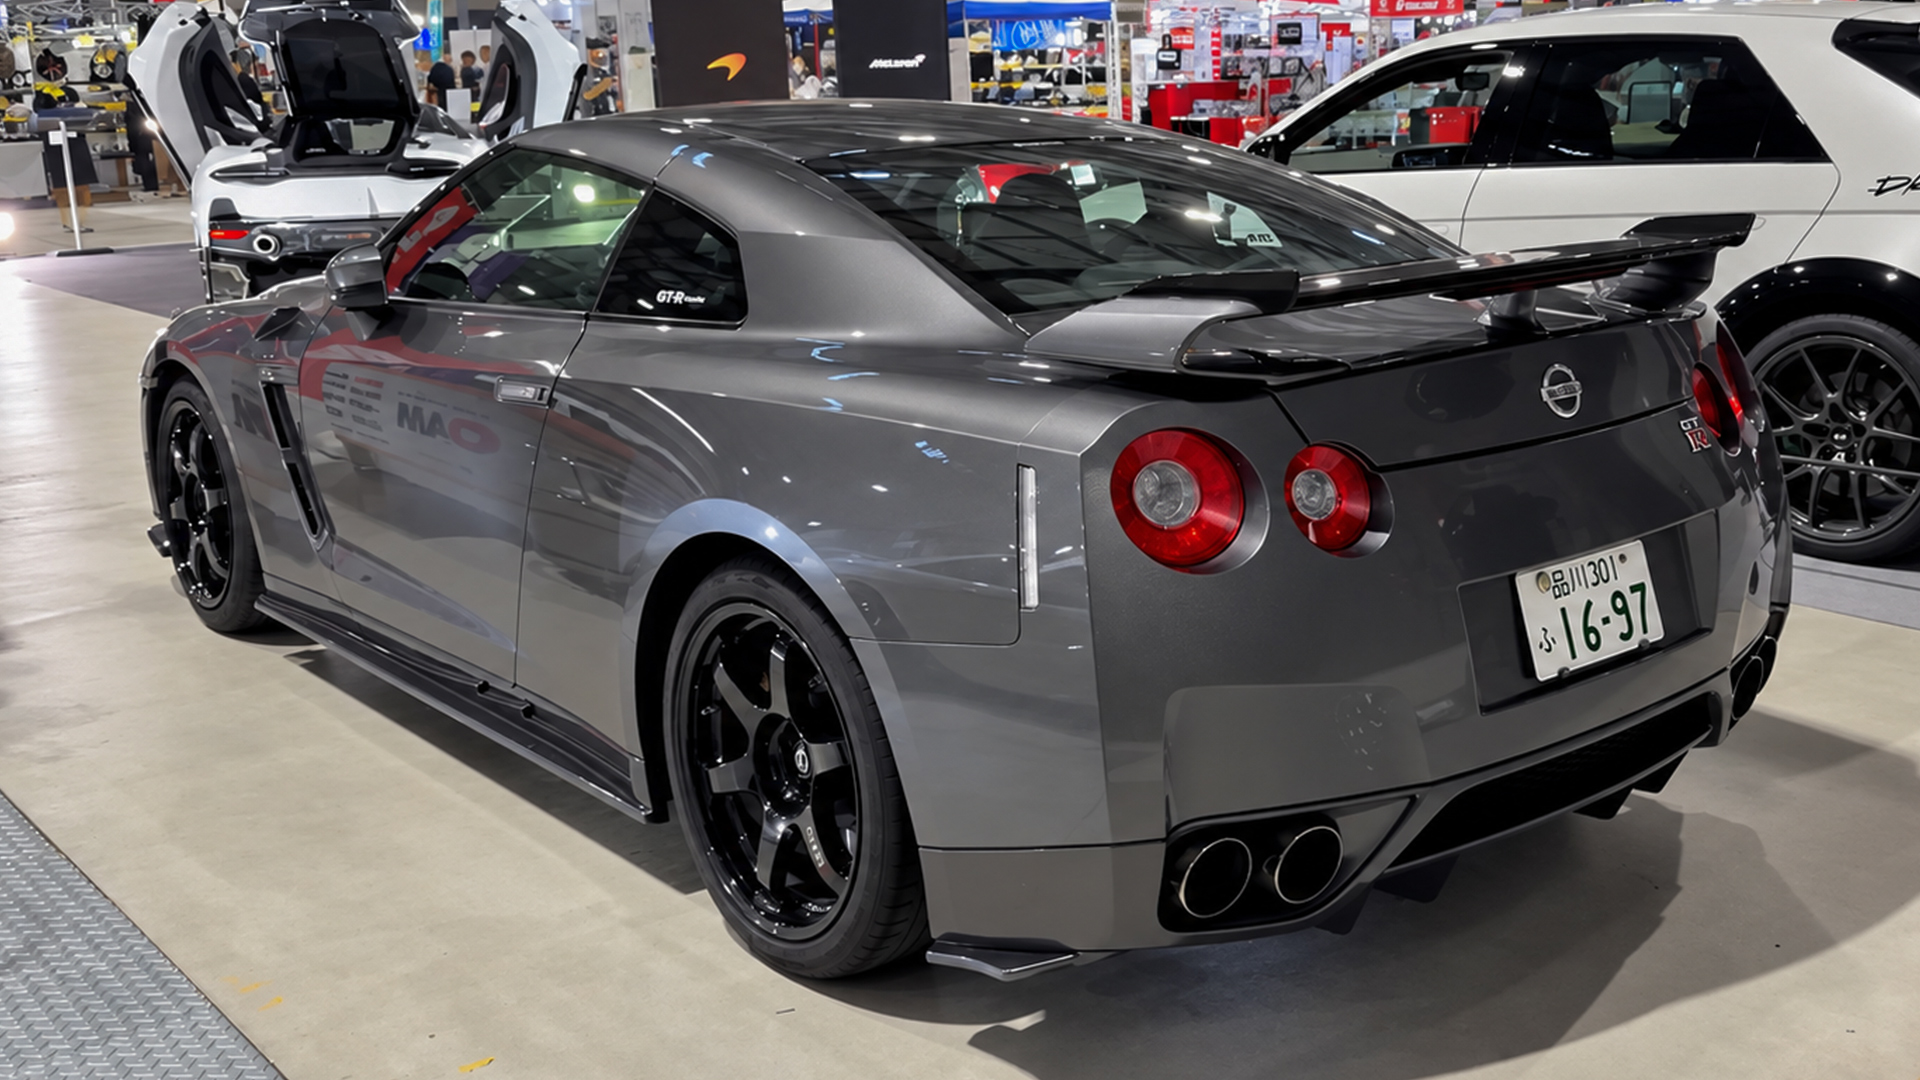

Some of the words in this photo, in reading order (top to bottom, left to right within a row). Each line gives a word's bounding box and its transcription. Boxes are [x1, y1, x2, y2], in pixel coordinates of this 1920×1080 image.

[656, 289, 685, 304] GT-R
[1539, 627, 1557, 653] ふ
[1560, 581, 1648, 660] 16-97
